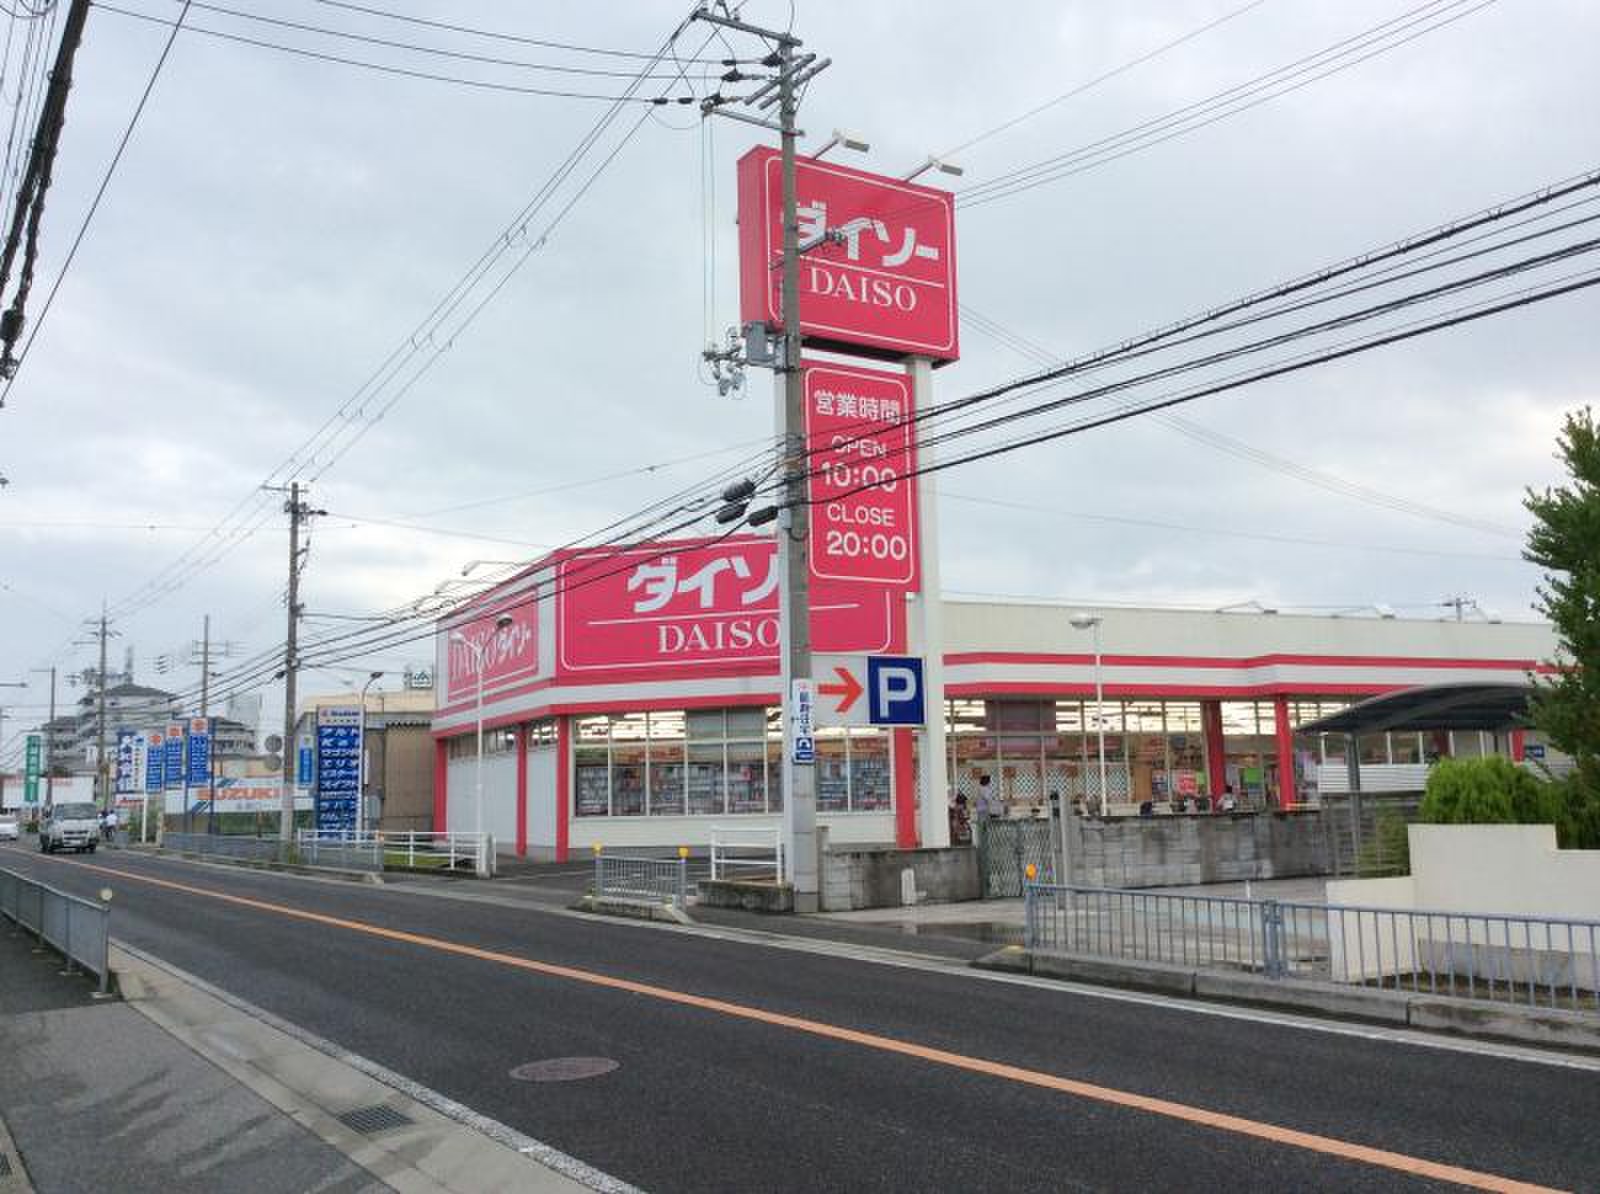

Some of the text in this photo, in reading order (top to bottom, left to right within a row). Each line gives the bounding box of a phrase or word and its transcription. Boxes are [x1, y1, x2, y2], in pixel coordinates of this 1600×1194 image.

[809, 266, 917, 312] DAISO
[814, 389, 901, 424] 営業時間
[831, 435, 887, 458] OPEN
[821, 461, 897, 492] 10:00
[827, 503, 895, 527] CLOSE
[826, 531, 907, 560] 20:00
[627, 555, 779, 613] ダイソ
[658, 618, 780, 653] DAISO
[879, 667, 917, 718] P
